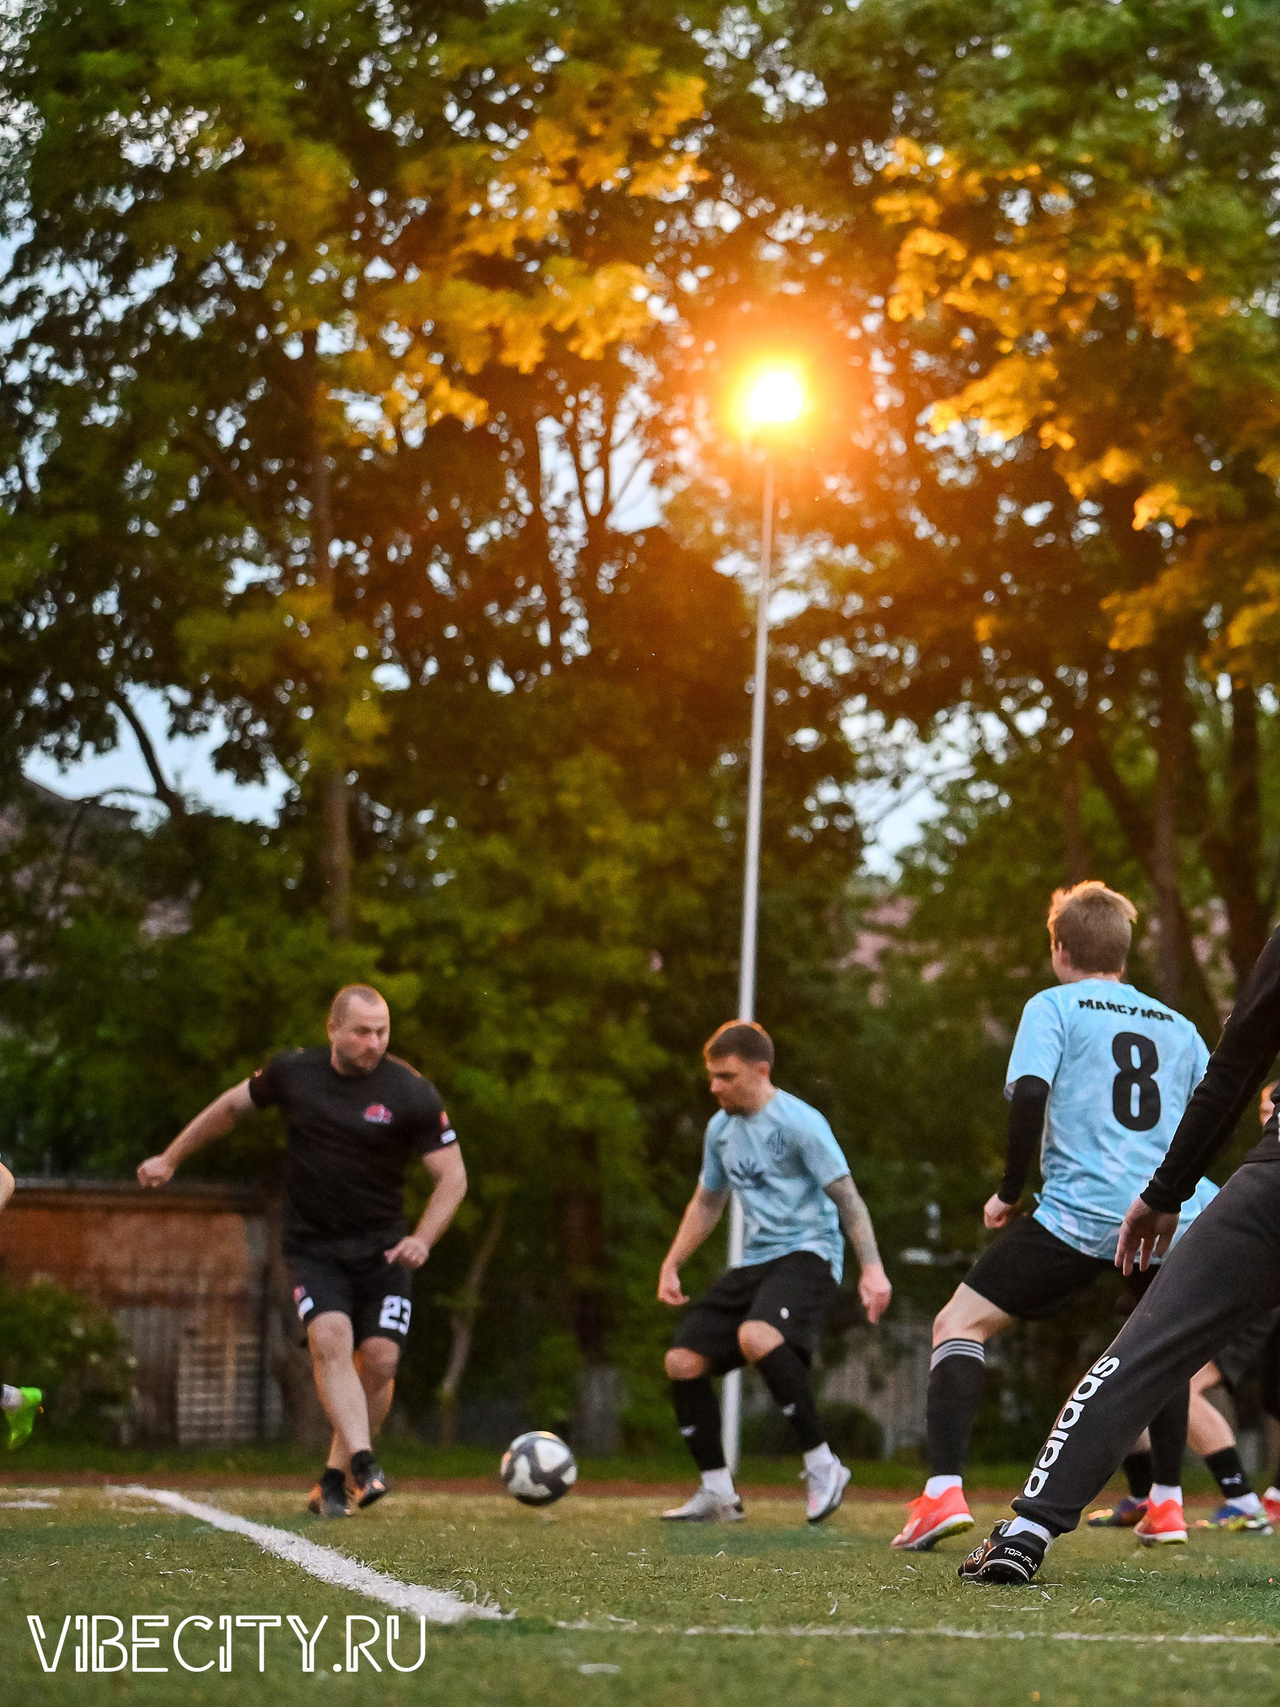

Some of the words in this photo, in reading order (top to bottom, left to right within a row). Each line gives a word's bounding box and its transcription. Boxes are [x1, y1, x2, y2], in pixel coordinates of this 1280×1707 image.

[1112, 1031, 1162, 1132] 8
[379, 1294, 412, 1335] 23
[1023, 1355, 1120, 1498] adidas
